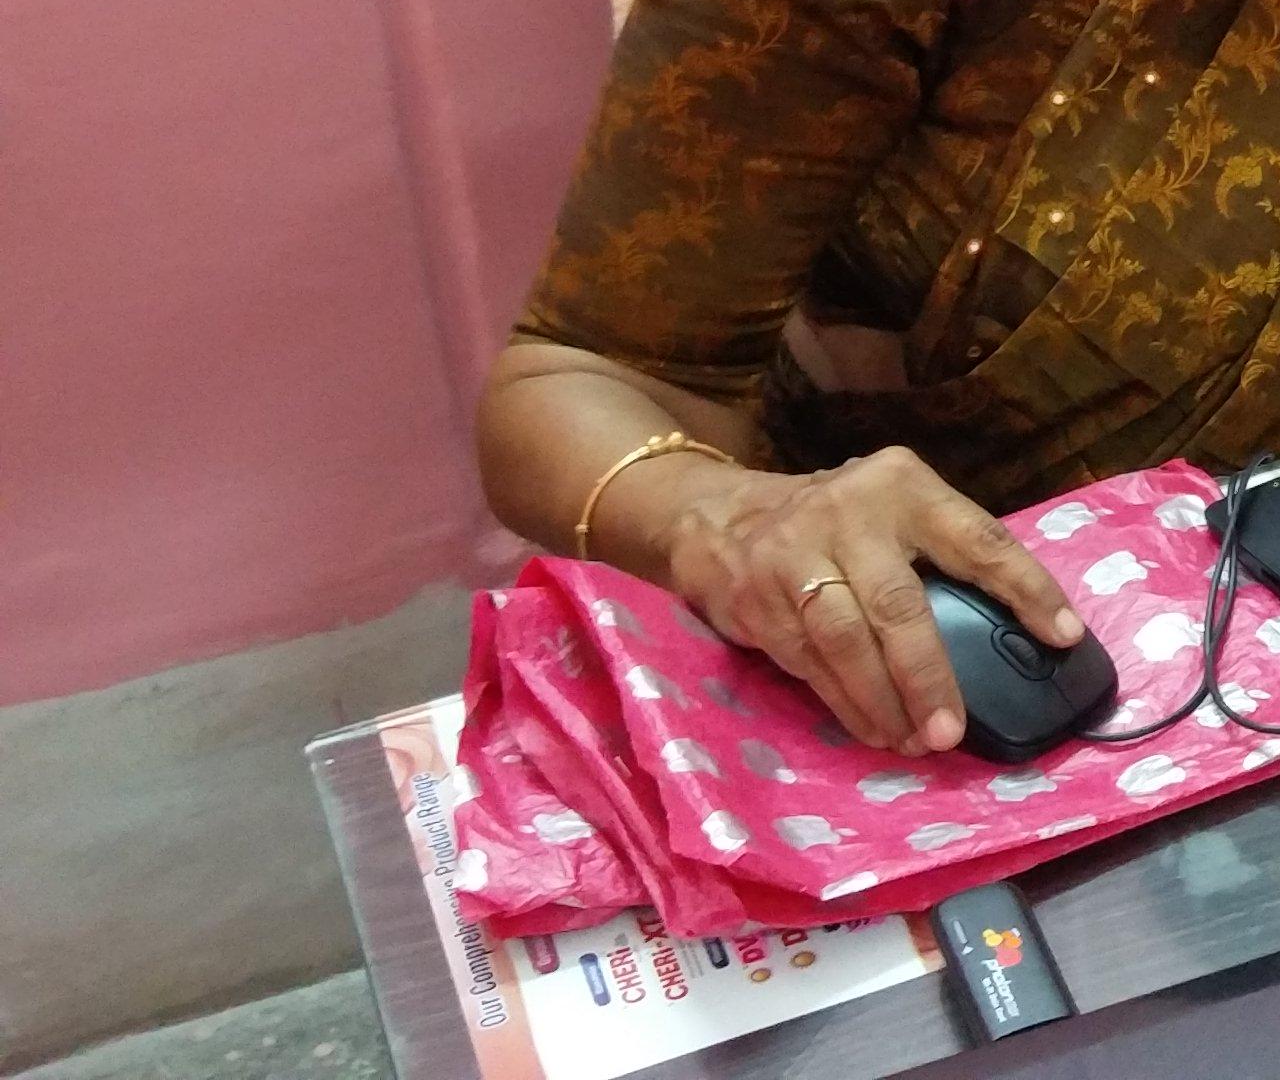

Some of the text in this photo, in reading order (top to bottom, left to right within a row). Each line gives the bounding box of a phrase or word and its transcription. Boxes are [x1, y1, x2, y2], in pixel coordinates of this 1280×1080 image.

[411, 772, 442, 820] Range
[422, 820, 457, 883] Product
[607, 946, 646, 1004] CHERI
[480, 997, 508, 1028] Our
